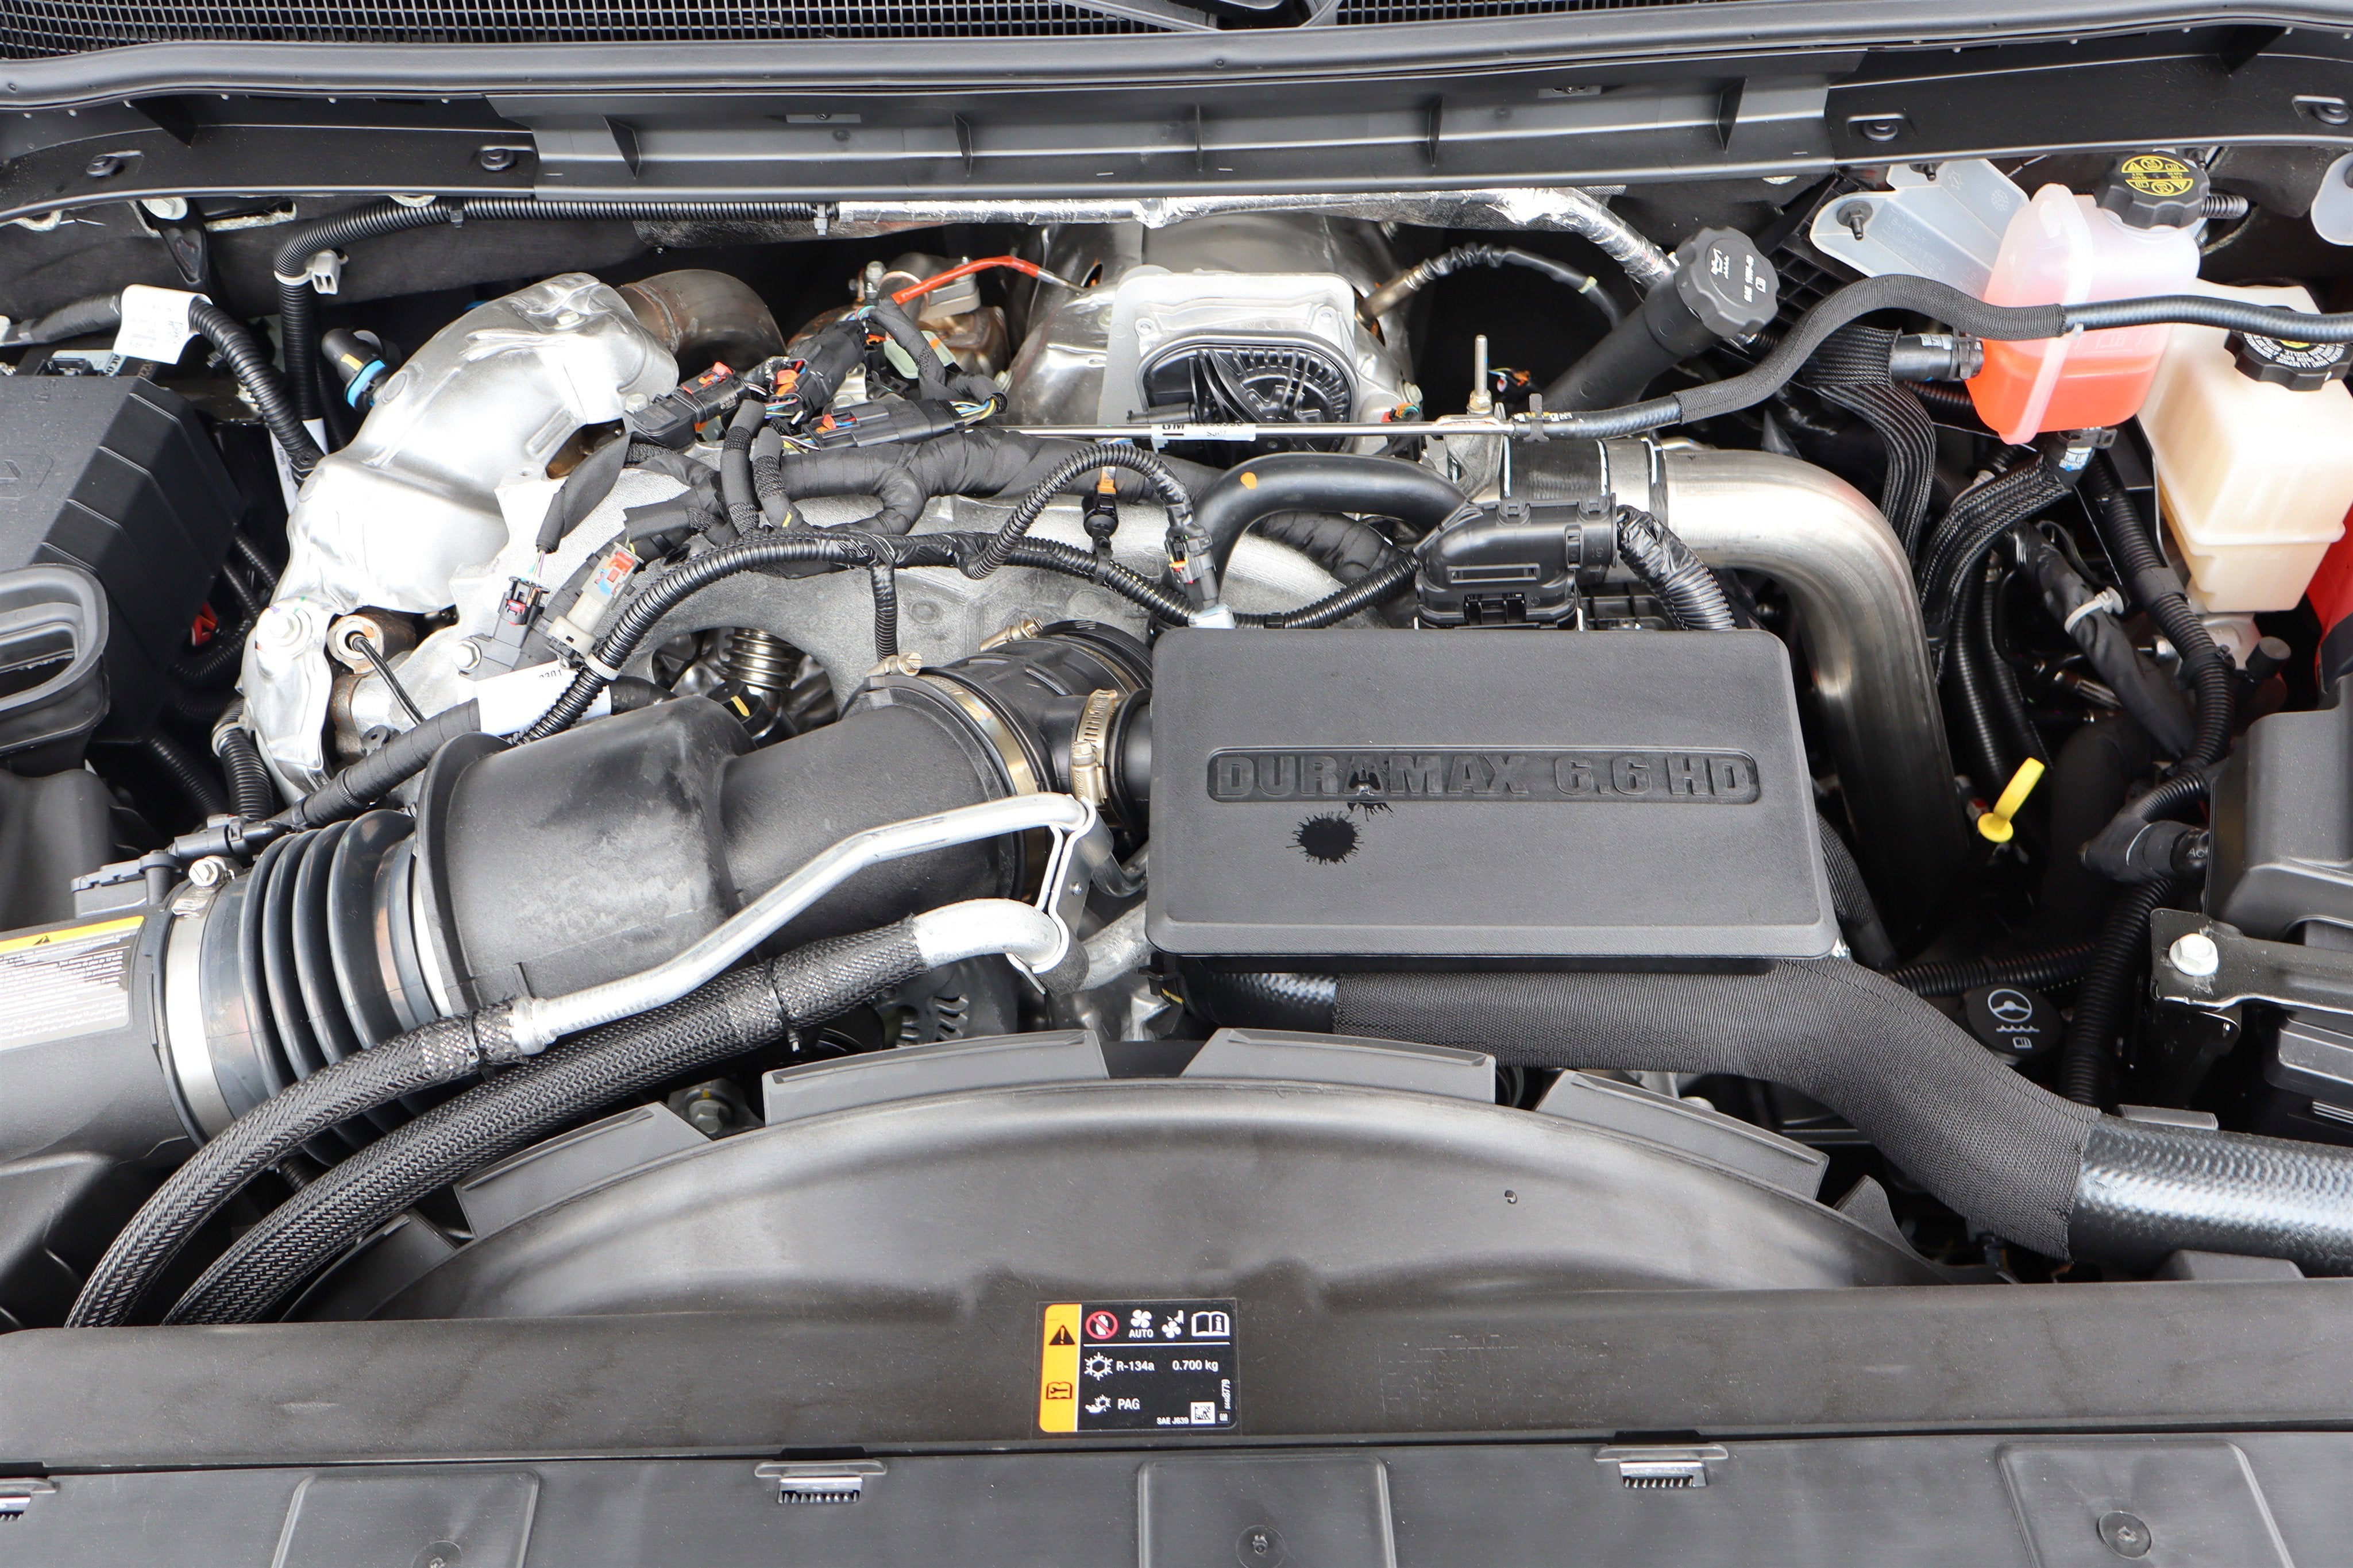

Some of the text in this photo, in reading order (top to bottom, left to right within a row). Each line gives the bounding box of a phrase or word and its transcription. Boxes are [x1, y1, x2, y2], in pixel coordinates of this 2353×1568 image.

[1216, 754, 1750, 797] DURAMAX 6.6 HD
[1129, 1328, 1154, 1339] AUTO
[1116, 1359, 1219, 1372] R-134a 0.700 kg
[1118, 1398, 1141, 1410] PAG
[1156, 1416, 1171, 1425] SAE
